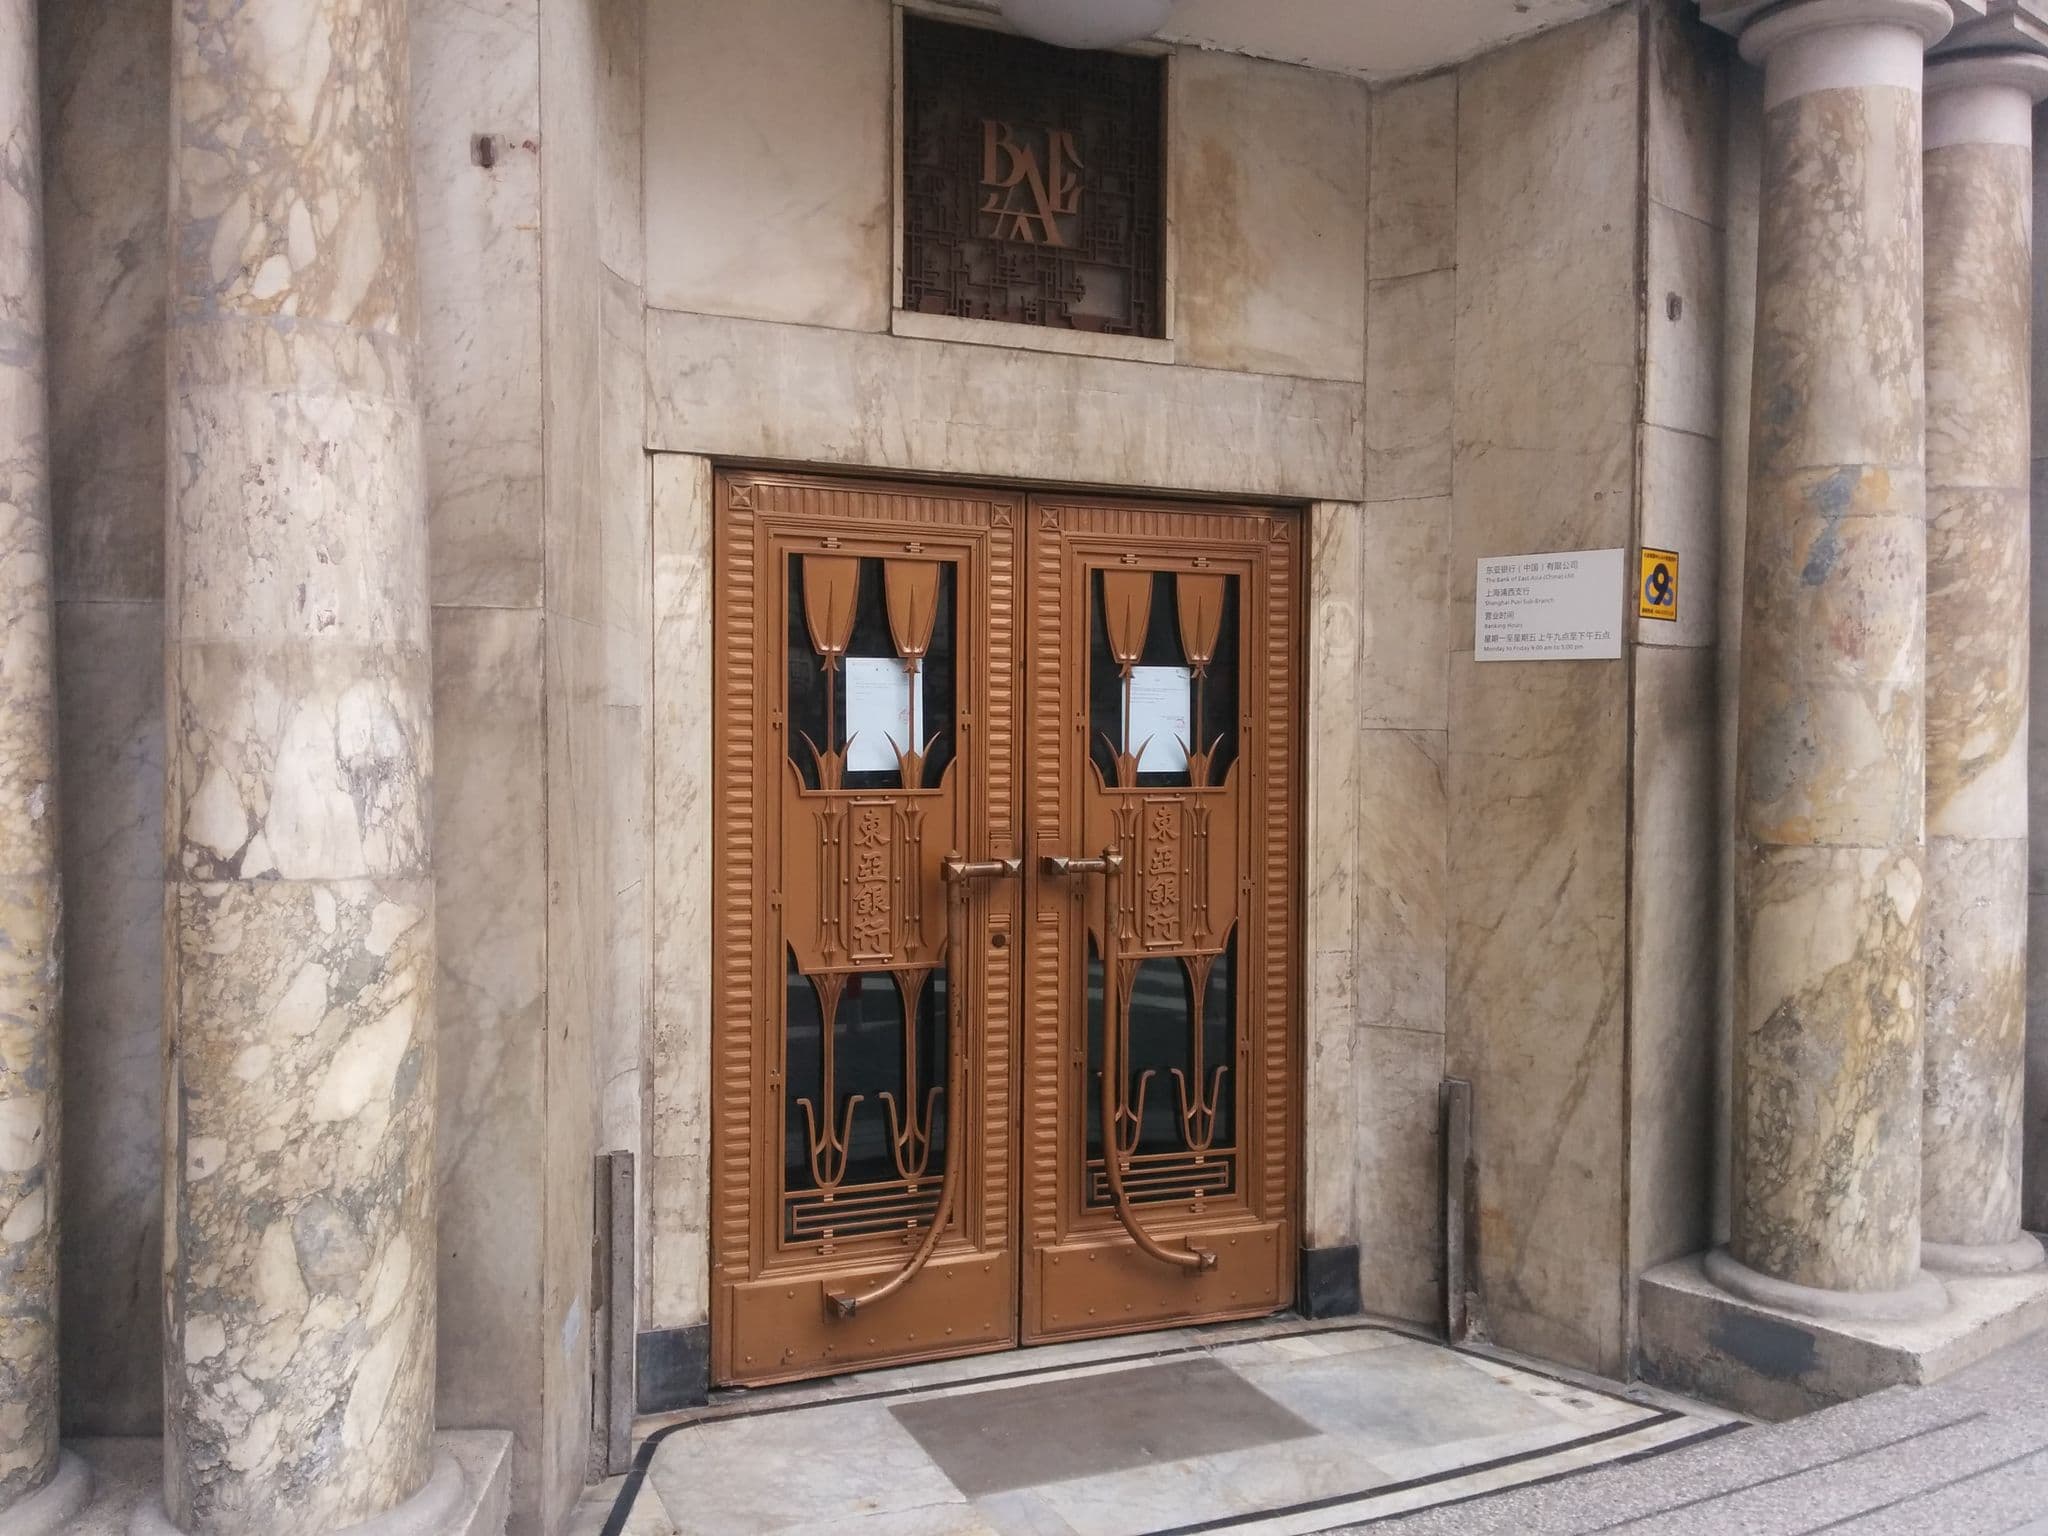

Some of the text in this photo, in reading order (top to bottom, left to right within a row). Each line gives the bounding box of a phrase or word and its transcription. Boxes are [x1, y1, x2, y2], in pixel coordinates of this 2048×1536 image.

[1486, 587, 1530, 598] 上海浦西支行
[1484, 610, 1514, 620] 营业时间
